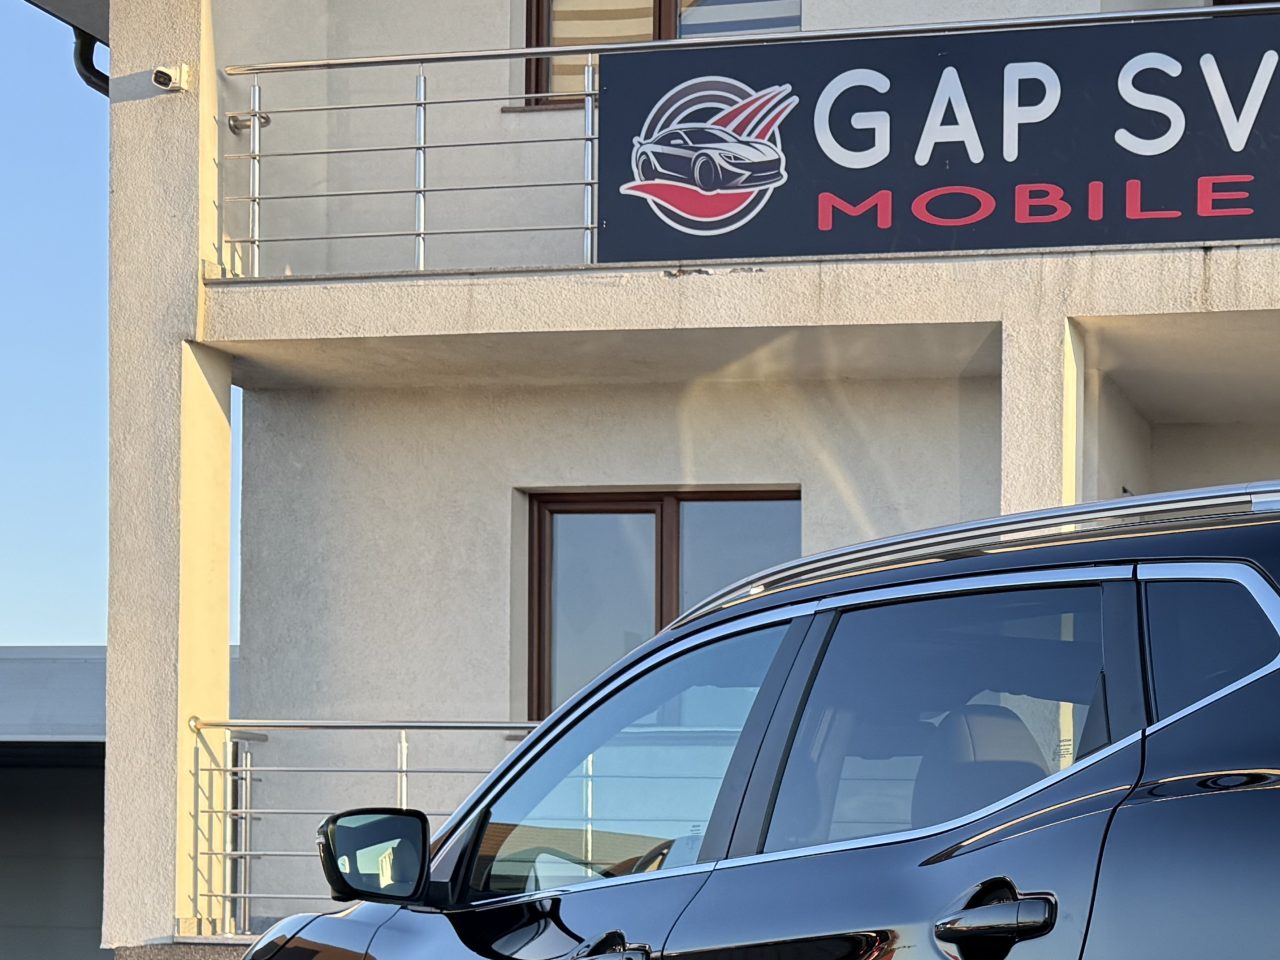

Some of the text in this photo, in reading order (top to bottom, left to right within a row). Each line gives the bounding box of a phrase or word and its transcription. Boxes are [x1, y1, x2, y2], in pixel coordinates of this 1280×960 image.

[813, 49, 1279, 169] GAP SV
[818, 174, 1255, 232] MOBILE
